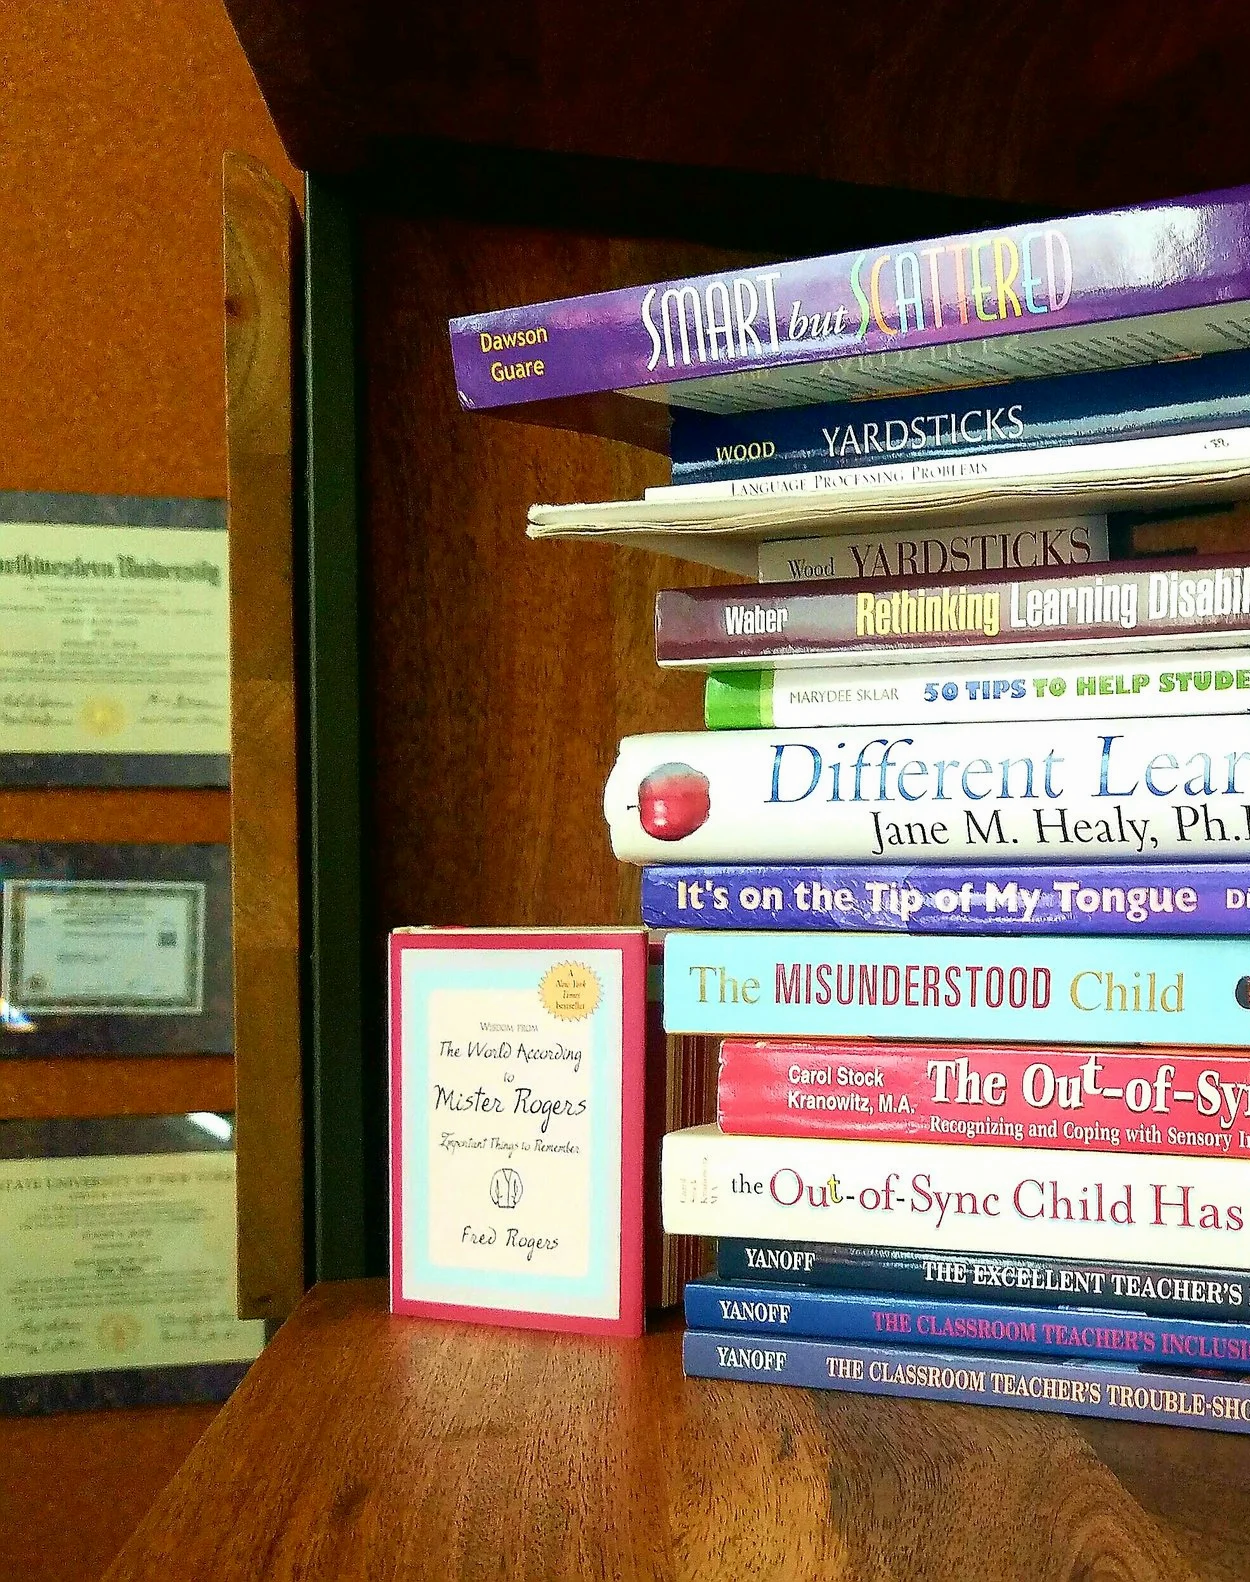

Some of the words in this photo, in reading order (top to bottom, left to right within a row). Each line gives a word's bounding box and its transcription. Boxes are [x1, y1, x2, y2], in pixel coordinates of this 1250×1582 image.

[641, 272, 782, 372] SMART
[788, 300, 848, 341] but
[850, 229, 1073, 341] SCATTERED
[480, 326, 548, 354] Dawson
[491, 357, 545, 382] Guare
[716, 441, 775, 462] WOOD
[822, 405, 1025, 457] YARDSTICKS
[788, 556, 835, 579] Wood
[848, 527, 1090, 578] YARDSTICKS
[725, 605, 788, 635] Waber
[856, 587, 1000, 637] Rethinking
[1010, 577, 1138, 629] Learning
[789, 689, 852, 704] MARYDEE
[856, 687, 899, 702] SKLAR
[924, 681, 959, 702] 50
[966, 678, 1027, 700] TIPS
[1033, 676, 1066, 697] TO
[1076, 673, 1151, 697] HELP
[764, 738, 1065, 802] Different
[869, 810, 950, 855] Jane
[963, 809, 1019, 845] M.
[1032, 804, 1158, 852] Healy,
[677, 879, 729, 910] It's
[739, 885, 783, 910] on
[794, 881, 855, 911] the
[866, 881, 923, 922] Tip
[934, 882, 974, 911] of
[986, 881, 1042, 922] My
[1053, 881, 1198, 922] Tongue
[689, 966, 760, 1004] The
[775, 962, 1050, 1009] MISUNDERSTOOD
[1070, 971, 1185, 1012] Child
[439, 1041, 461, 1058] The
[467, 1041, 512, 1059] World
[517, 1042, 582, 1073] According
[787, 1064, 832, 1086] Carol
[836, 1066, 884, 1088] Stock
[926, 1056, 1008, 1106] The
[434, 1084, 505, 1113] Mister
[514, 1087, 587, 1134] Rogers
[788, 1090, 874, 1116] Kranowitz,
[878, 1093, 916, 1115] M.A.
[930, 1114, 1024, 1141] Recognizing
[1029, 1119, 1058, 1139] and
[1063, 1121, 1121, 1146] Coping
[1126, 1125, 1164, 1145] with
[1167, 1127, 1232, 1151] Sensory
[732, 1173, 763, 1195] the
[769, 1167, 1001, 1229] Out-of-Sync
[1012, 1179, 1136, 1226] Child
[1150, 1184, 1244, 1231] Has
[461, 1225, 497, 1245] Fred
[506, 1228, 559, 1261] Rogers
[745, 1248, 815, 1272] YANOFF
[922, 1260, 967, 1284] THE
[972, 1264, 1105, 1295] EXCELLENT
[1111, 1273, 1243, 1306] TEACHER'S
[719, 1300, 791, 1324] YANOFF
[872, 1311, 912, 1333] THE
[916, 1315, 1036, 1343] CLASSROOM
[1042, 1323, 1155, 1352] TEACHER'S
[716, 1346, 787, 1371] YANOFF
[826, 1357, 864, 1380] THE
[869, 1361, 985, 1392] CLASSROOM
[990, 1373, 1101, 1404] TEACHER'S
